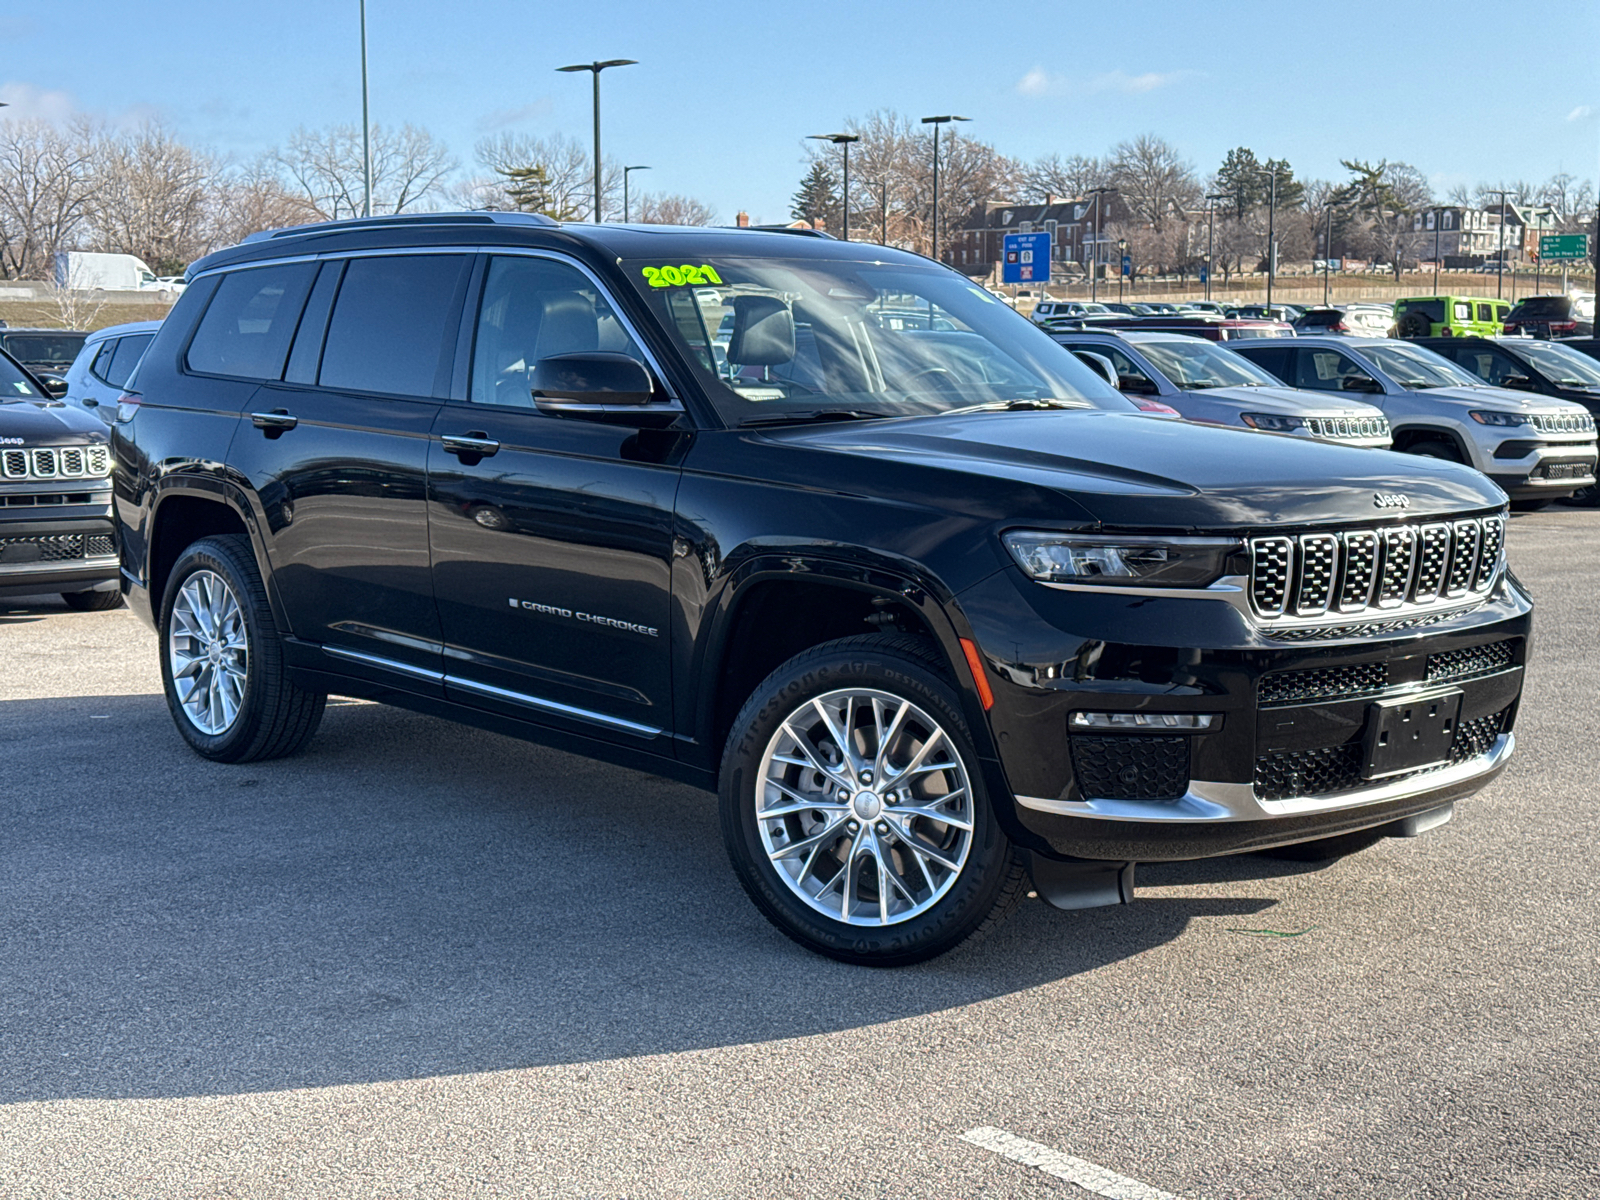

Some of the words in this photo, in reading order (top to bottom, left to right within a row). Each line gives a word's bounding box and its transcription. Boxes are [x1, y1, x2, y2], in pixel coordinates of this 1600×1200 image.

[642, 264, 723, 288] 2021
[1375, 493, 1409, 509] Jeep
[521, 600, 573, 618] GRAND
[575, 611, 659, 638] CHEROKEE
[737, 665, 831, 757] Firestone
[884, 669, 967, 731] DESTINATION
[862, 794, 873, 817] Jeep
